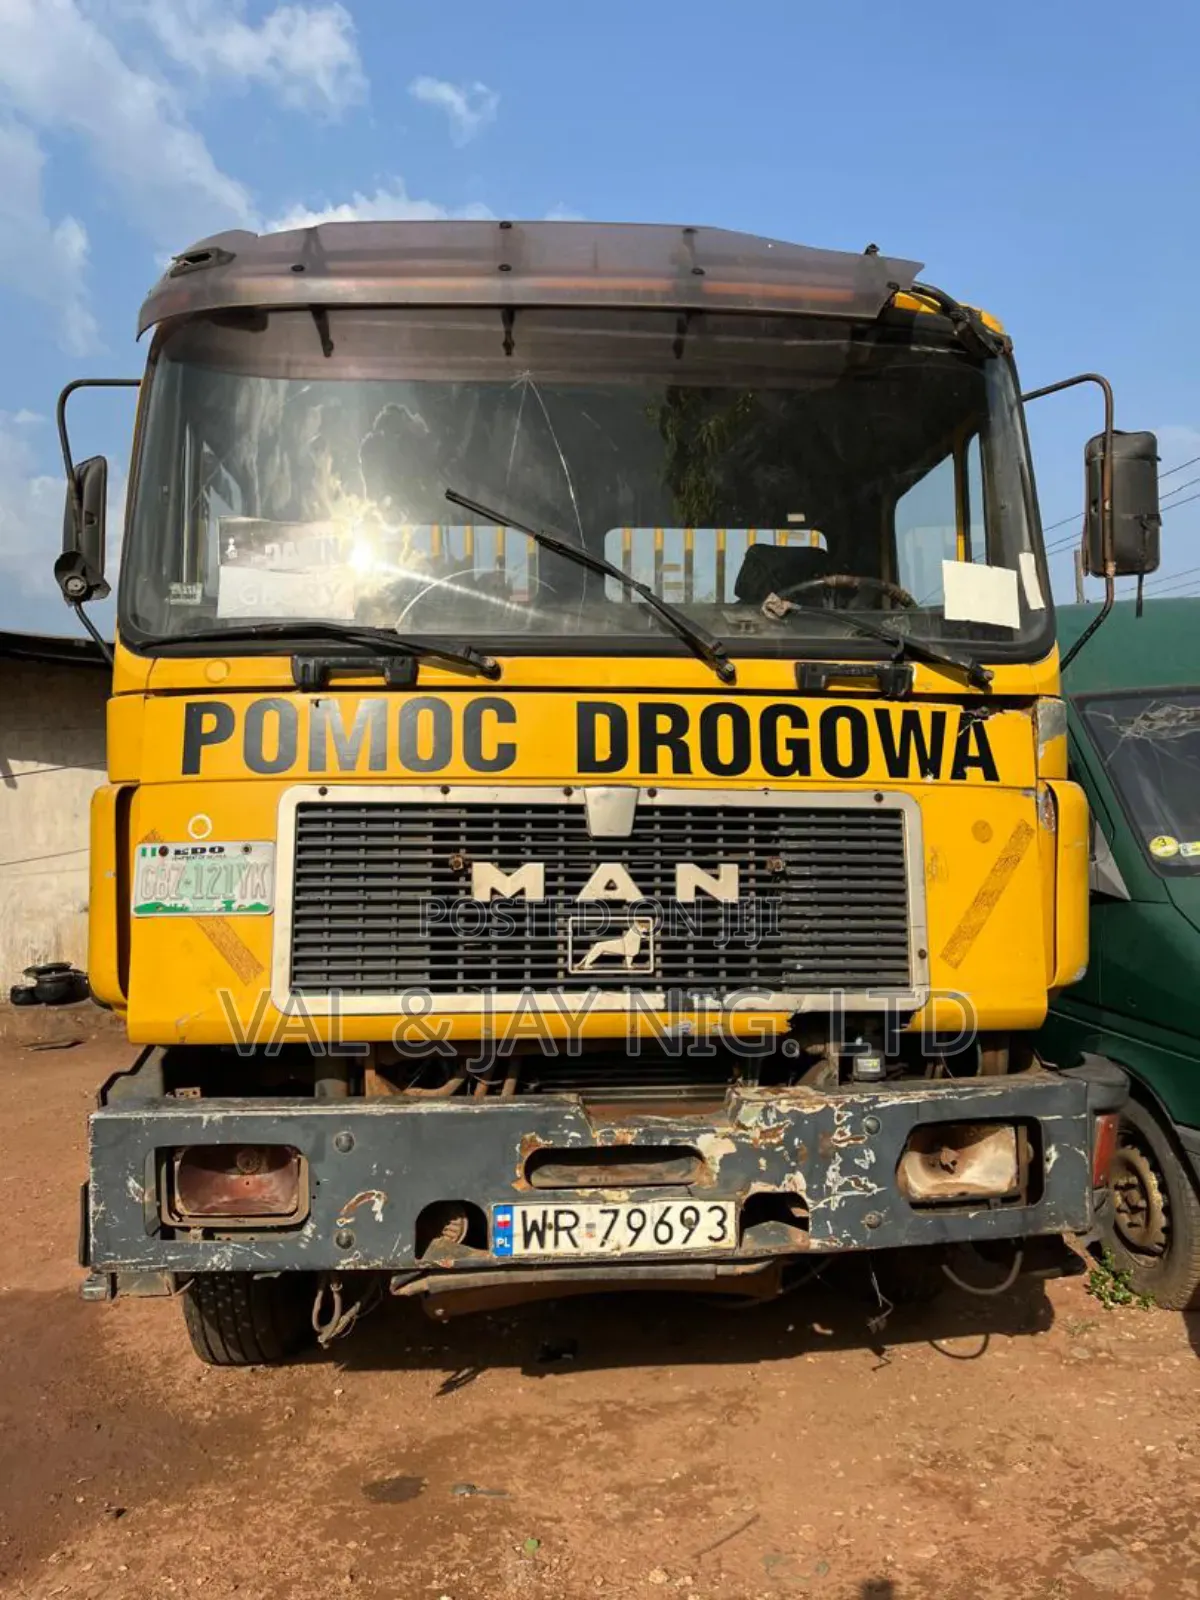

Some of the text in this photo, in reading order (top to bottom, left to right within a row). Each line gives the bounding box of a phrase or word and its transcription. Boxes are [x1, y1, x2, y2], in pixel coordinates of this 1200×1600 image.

[182, 696, 1000, 783] POMOC DROGOWA
[471, 862, 740, 904] MAN
[496, 1238, 511, 1248] PL
[521, 1205, 728, 1249] WR 79693
